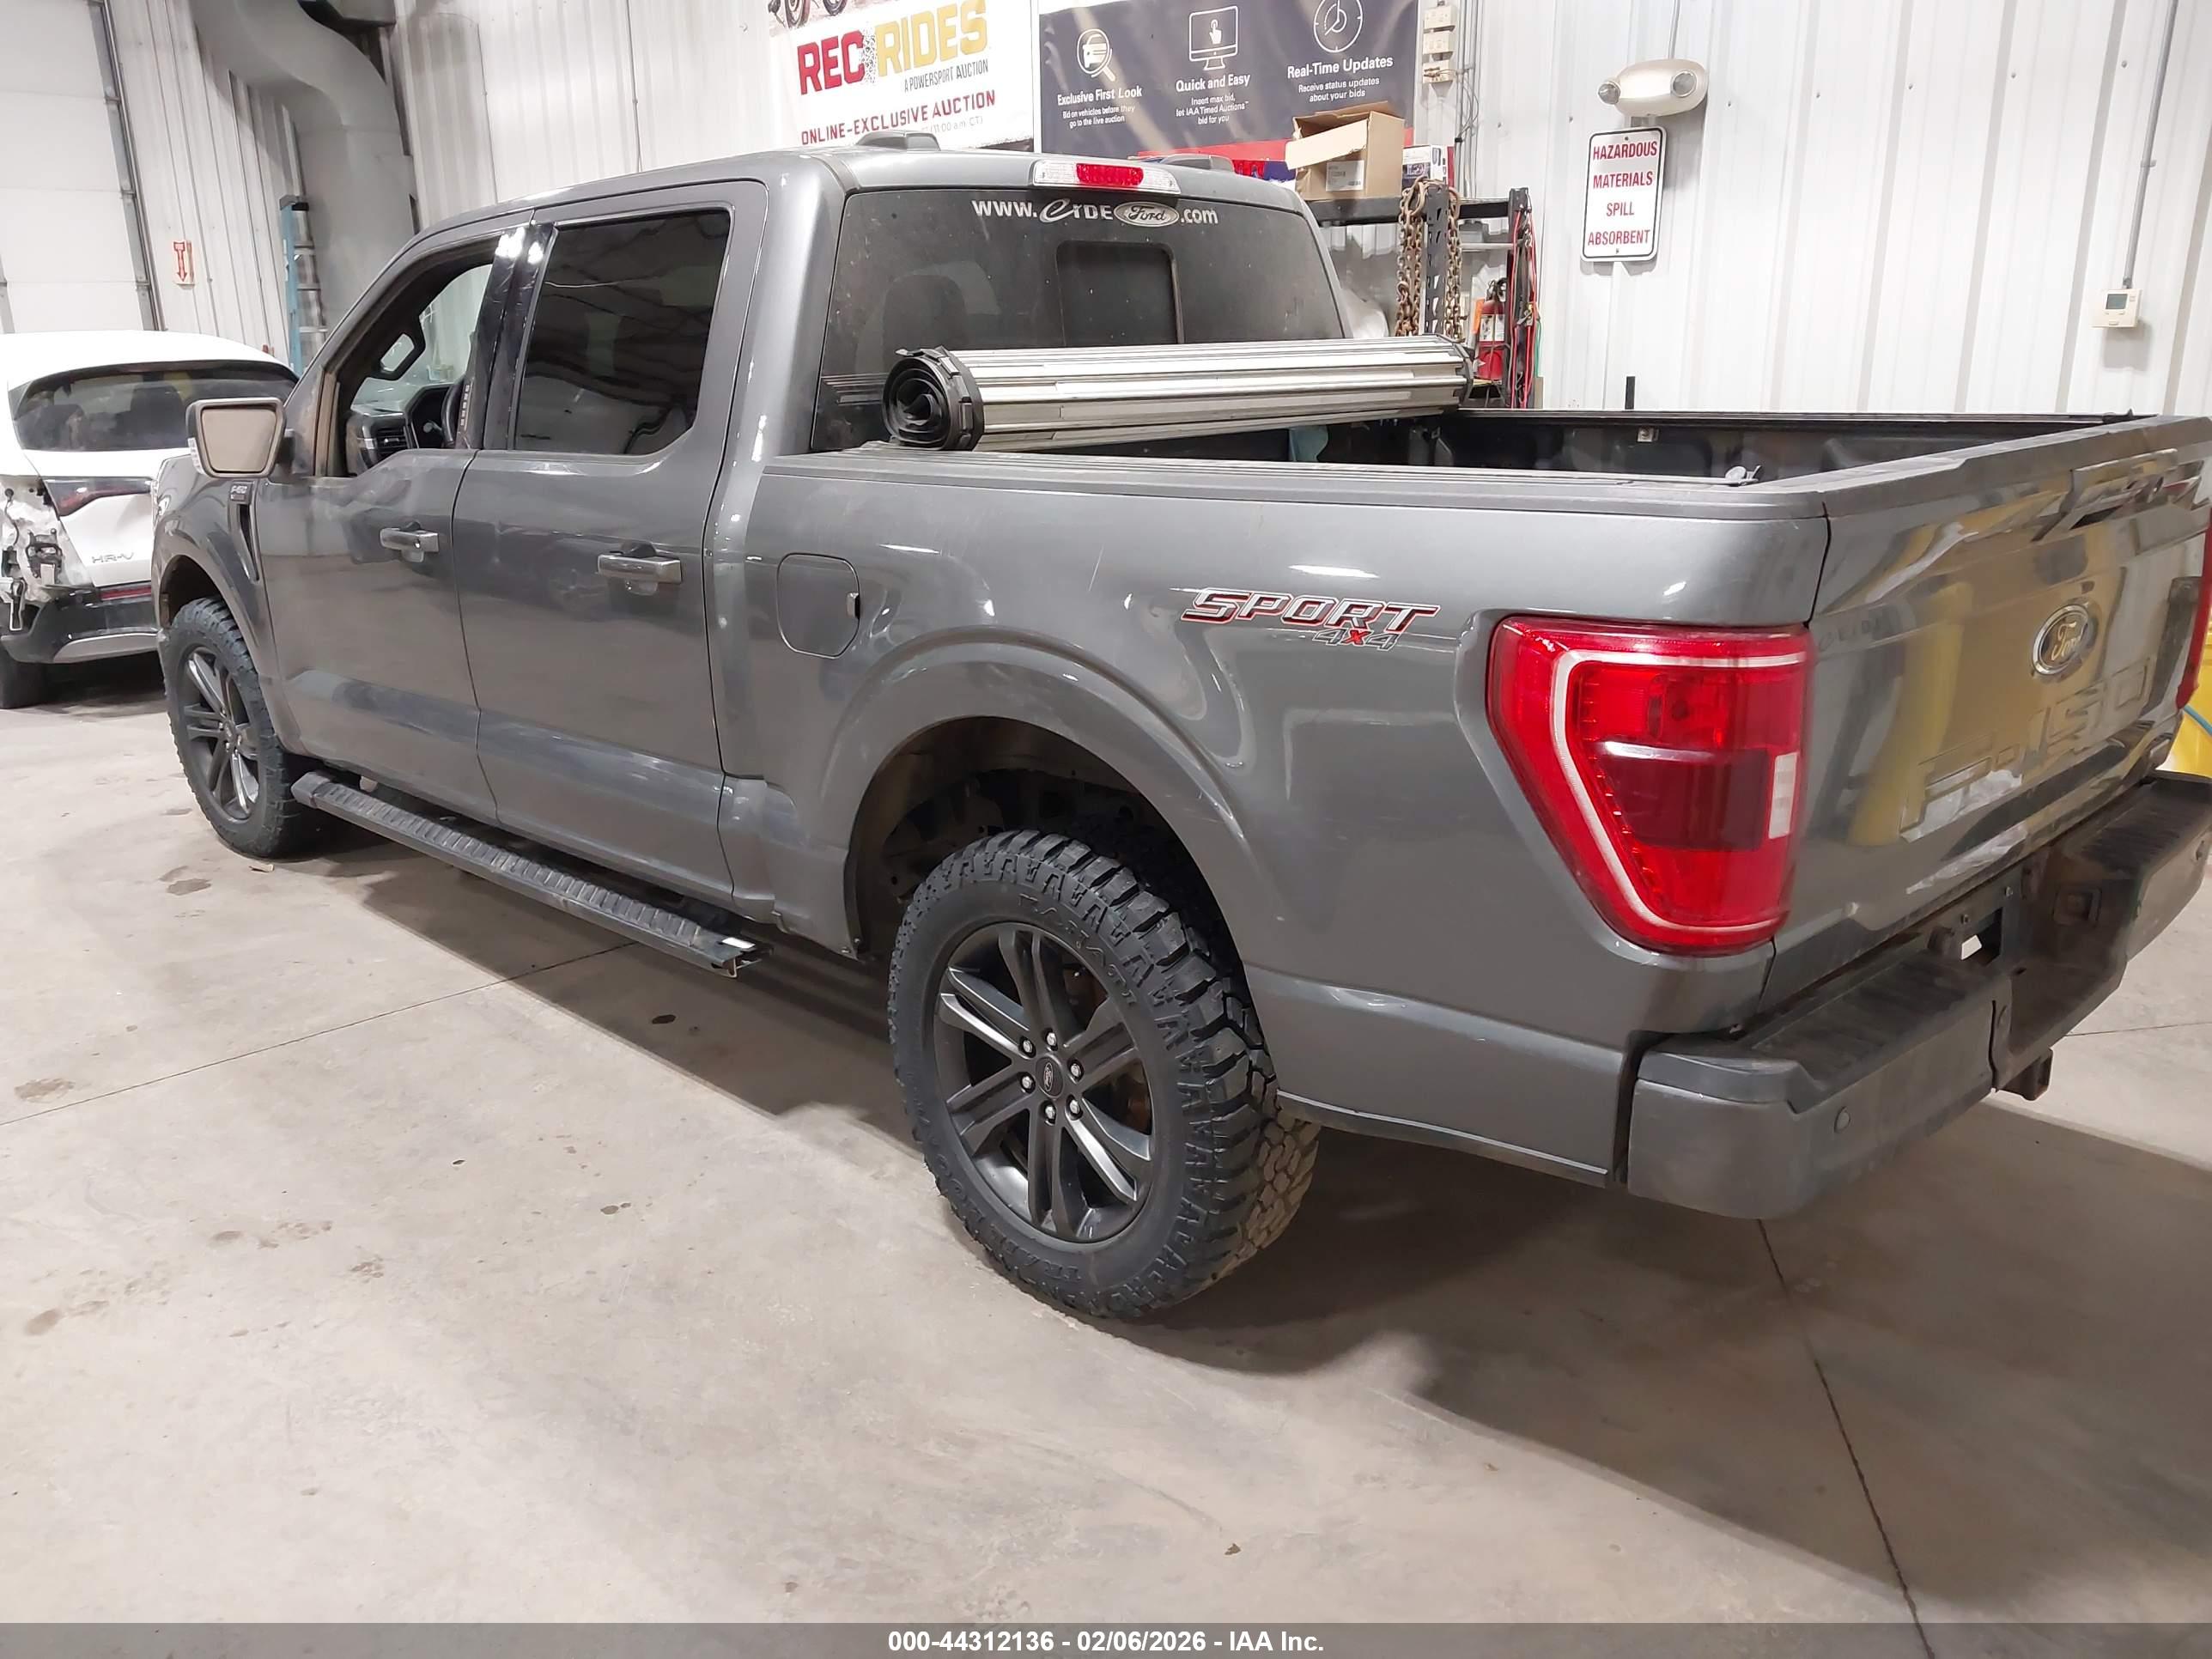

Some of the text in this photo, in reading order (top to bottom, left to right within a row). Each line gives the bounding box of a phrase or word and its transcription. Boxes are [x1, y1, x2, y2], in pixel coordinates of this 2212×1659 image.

[797, 0, 988, 95] REC RIDES
[904, 58, 988, 93] A POWERSPORT AUCTION
[1287, 57, 1394, 79] Real-Time Updates
[1176, 73, 1250, 92] Quick and Easy
[1298, 77, 1380, 94] Receive status updates
[1057, 85, 1143, 106] Exclusive First Look
[1191, 96, 1209, 106] Insert
[1209, 95, 1224, 104] max
[1310, 88, 1366, 102] about your bids
[801, 89, 995, 145] ONLINE-EXCLUSIVE AUCTION
[1062, 110, 1071, 118] Bid
[1079, 107, 1102, 117] vehicles
[1102, 106, 1120, 114] before
[1176, 108, 1185, 118] let
[1186, 107, 1200, 116] IAA
[1199, 105, 1218, 114] Timed
[1198, 114, 1230, 125] bid for you
[1069, 120, 1077, 129] go
[1093, 116, 1104, 125] live
[1104, 114, 1125, 124] auction
[1592, 141, 1658, 161] HAZARDOUS
[1593, 171, 1653, 189] MATERIALS
[1606, 201, 1635, 217] SPILL
[1588, 229, 1651, 246] ABSORBENT
[92, 552, 134, 563] HR-V
[1181, 587, 1441, 633] SPORT
